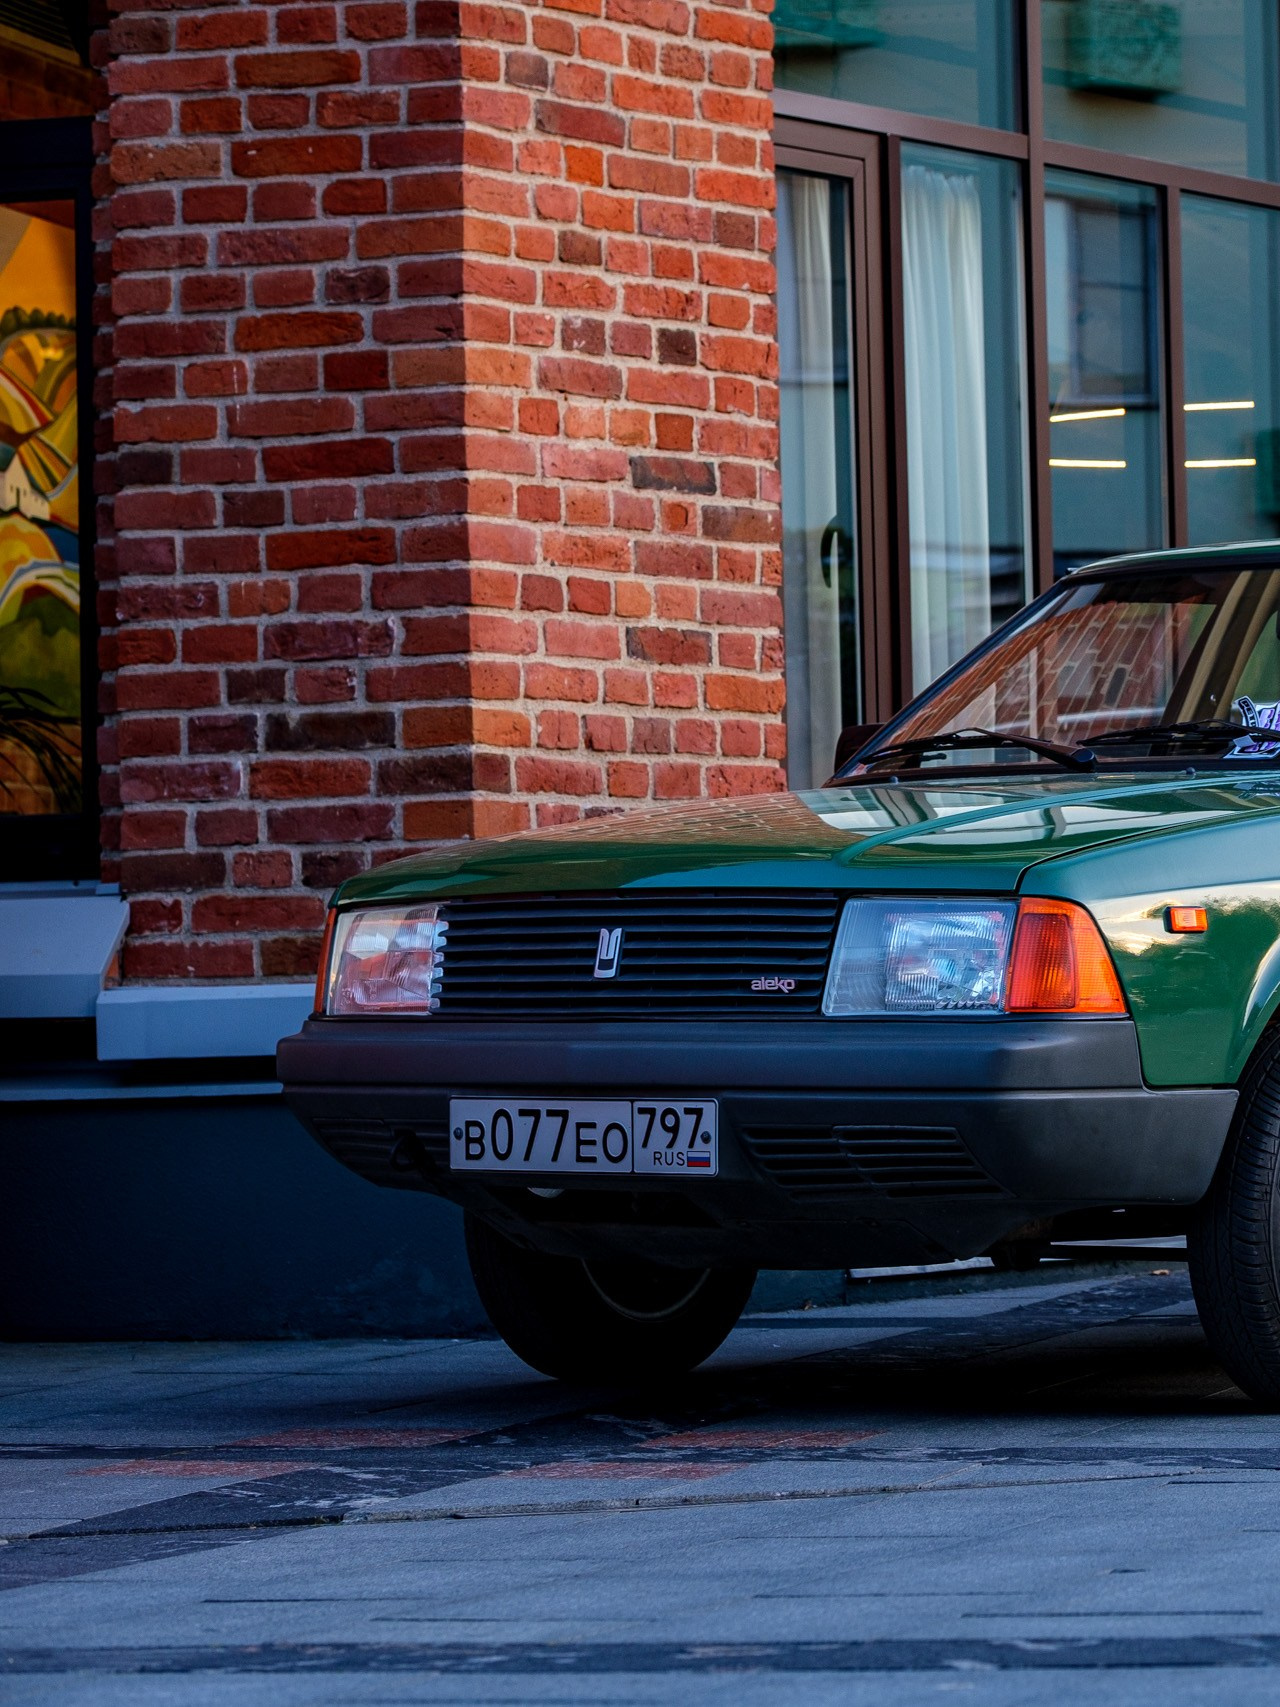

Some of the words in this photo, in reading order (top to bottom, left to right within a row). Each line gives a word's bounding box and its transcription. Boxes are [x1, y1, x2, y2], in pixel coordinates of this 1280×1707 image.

[751, 977, 795, 993] aleko
[464, 1108, 629, 1164] В077ЕО
[637, 1106, 705, 1149] 797
[653, 1151, 686, 1167] RUS
